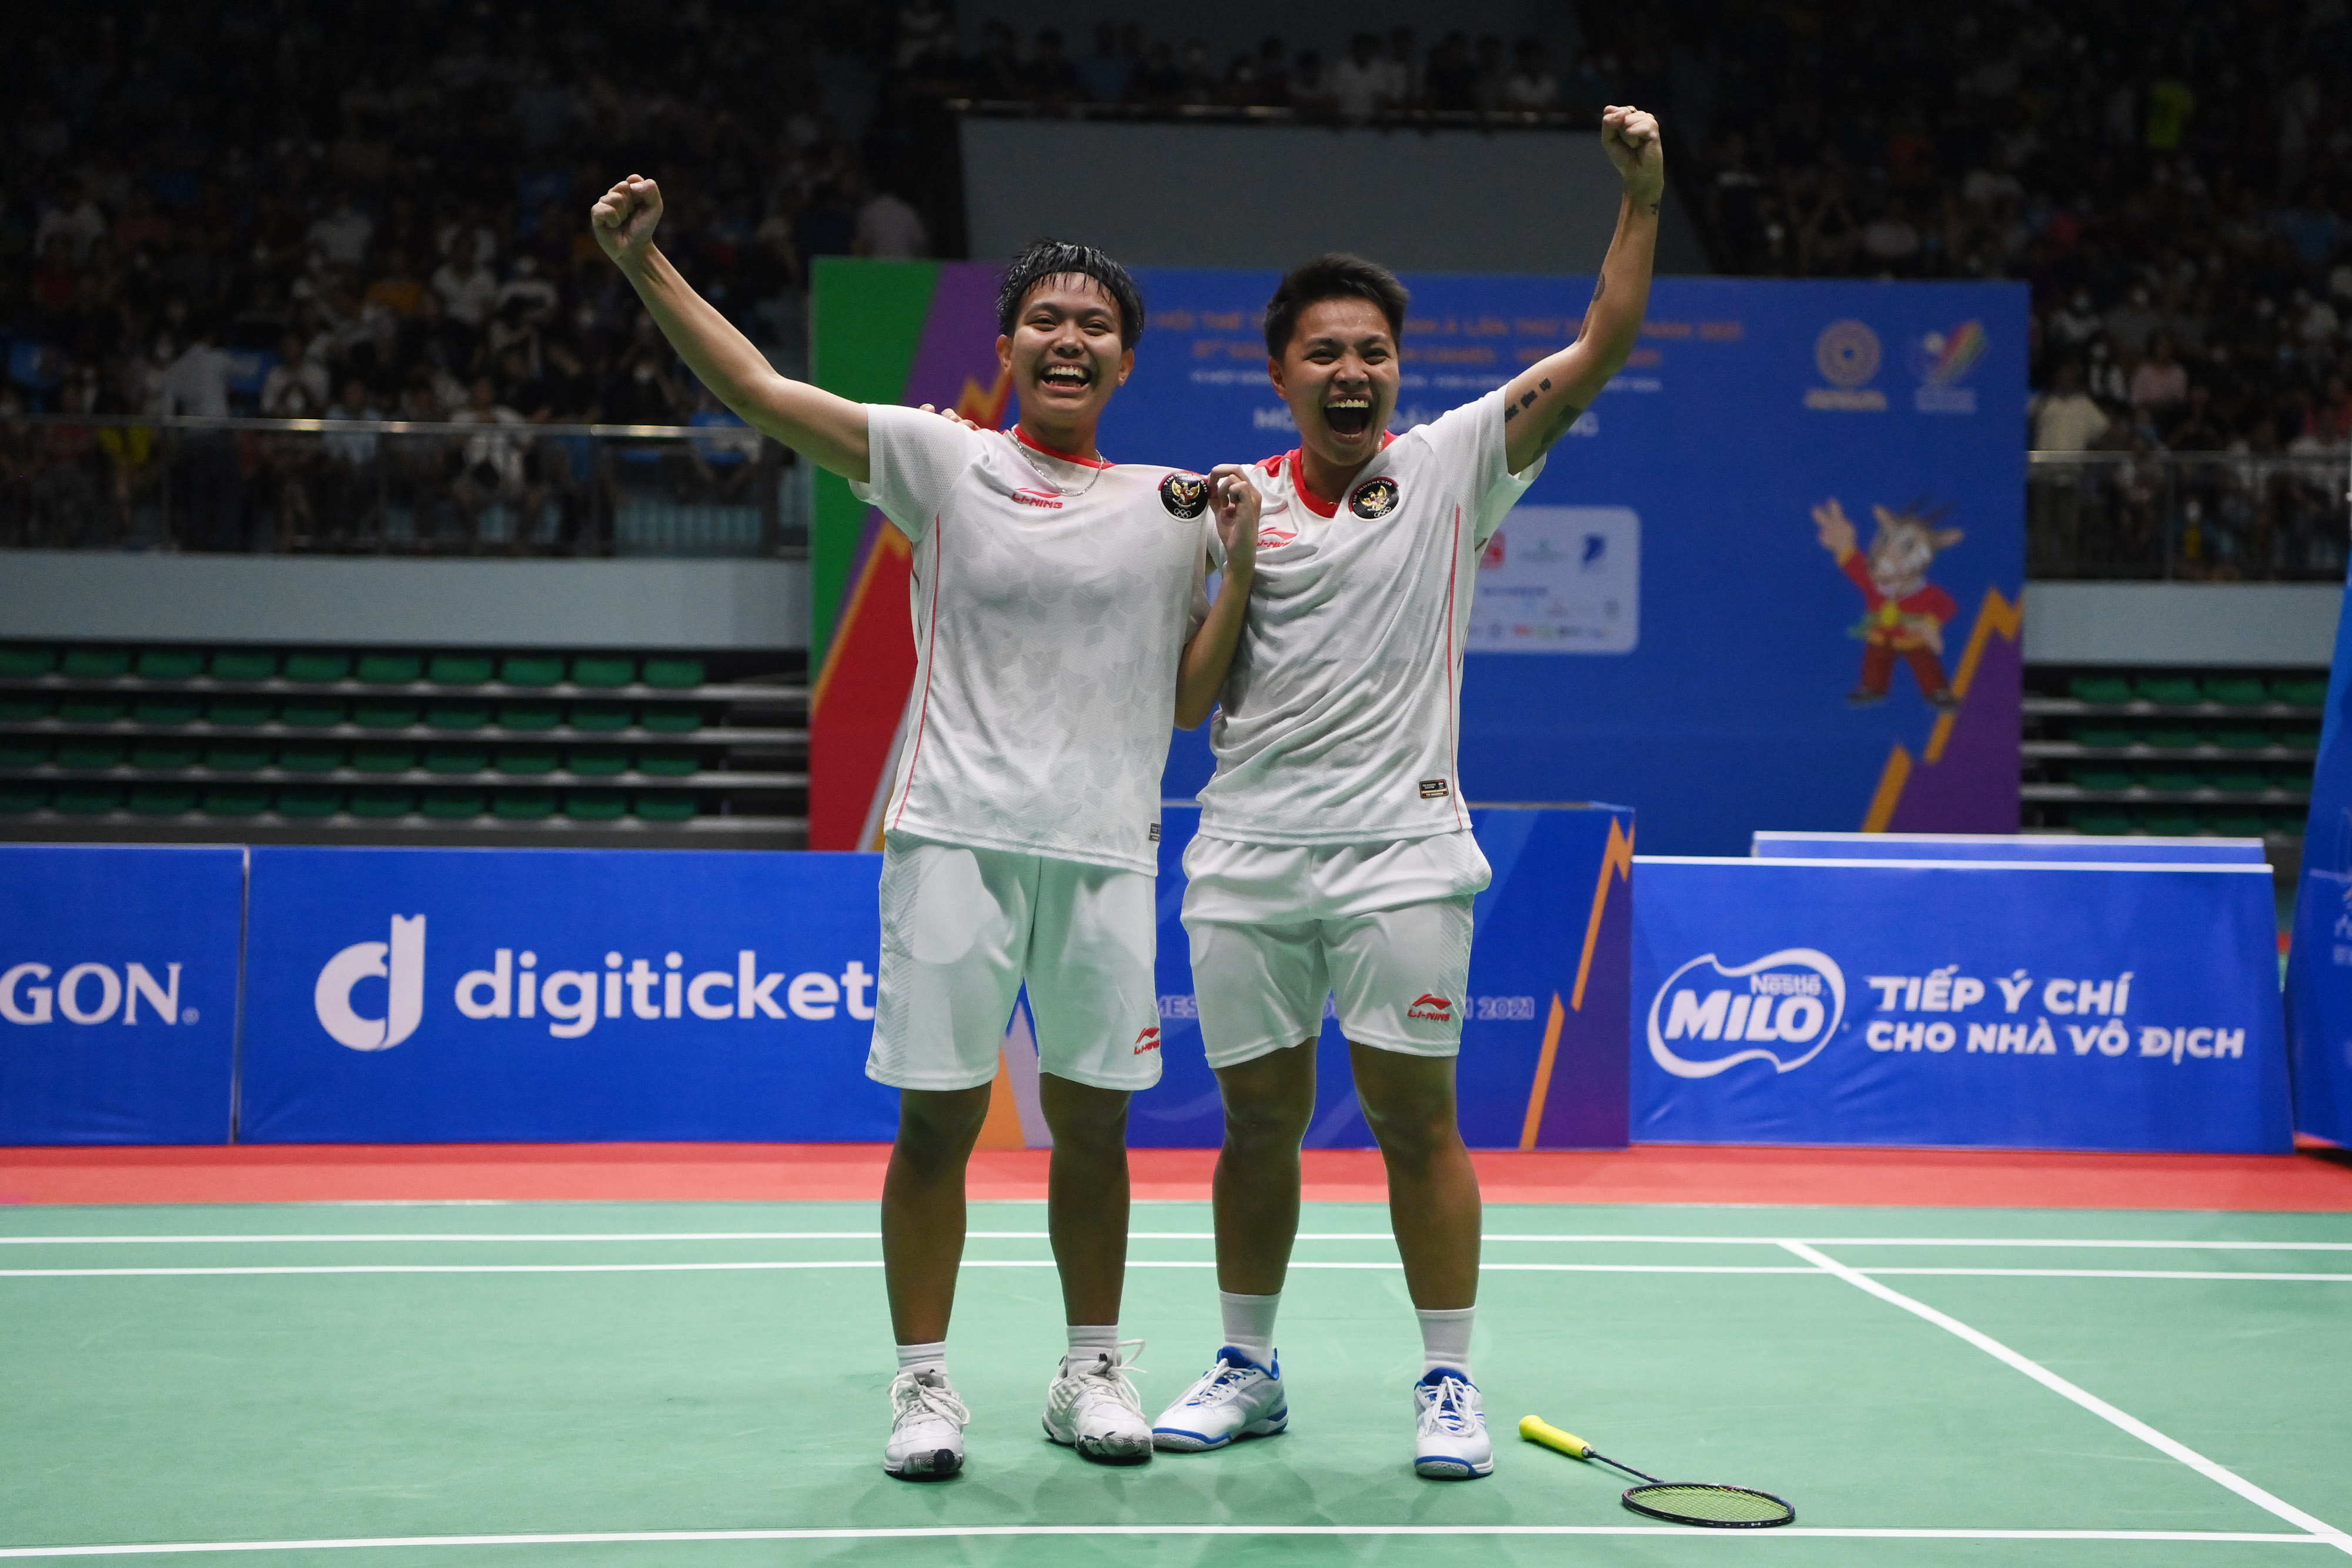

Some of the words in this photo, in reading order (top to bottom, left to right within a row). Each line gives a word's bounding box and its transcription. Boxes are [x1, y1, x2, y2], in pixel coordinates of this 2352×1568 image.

[1011, 493, 1063, 509] LI-NING
[1357, 480, 1393, 493] INDONESIA
[0, 962, 182, 1025] GON
[454, 948, 875, 1038] digiticket
[1157, 995, 1198, 1018] MES
[1477, 995, 1535, 1019] 2021
[1866, 965, 1986, 1012] TIẾP
[1996, 969, 2033, 1013] Ý
[2043, 971, 2135, 1015] CHÍ
[1408, 1008, 1451, 1021] LI-NING
[1665, 989, 1825, 1042] MILO
[1866, 1020, 1956, 1052] CHO
[1965, 1017, 2057, 1054] NHÀ
[2065, 1018, 2130, 1057] VÔ
[2138, 1026, 2246, 1065] ĐỊCH
